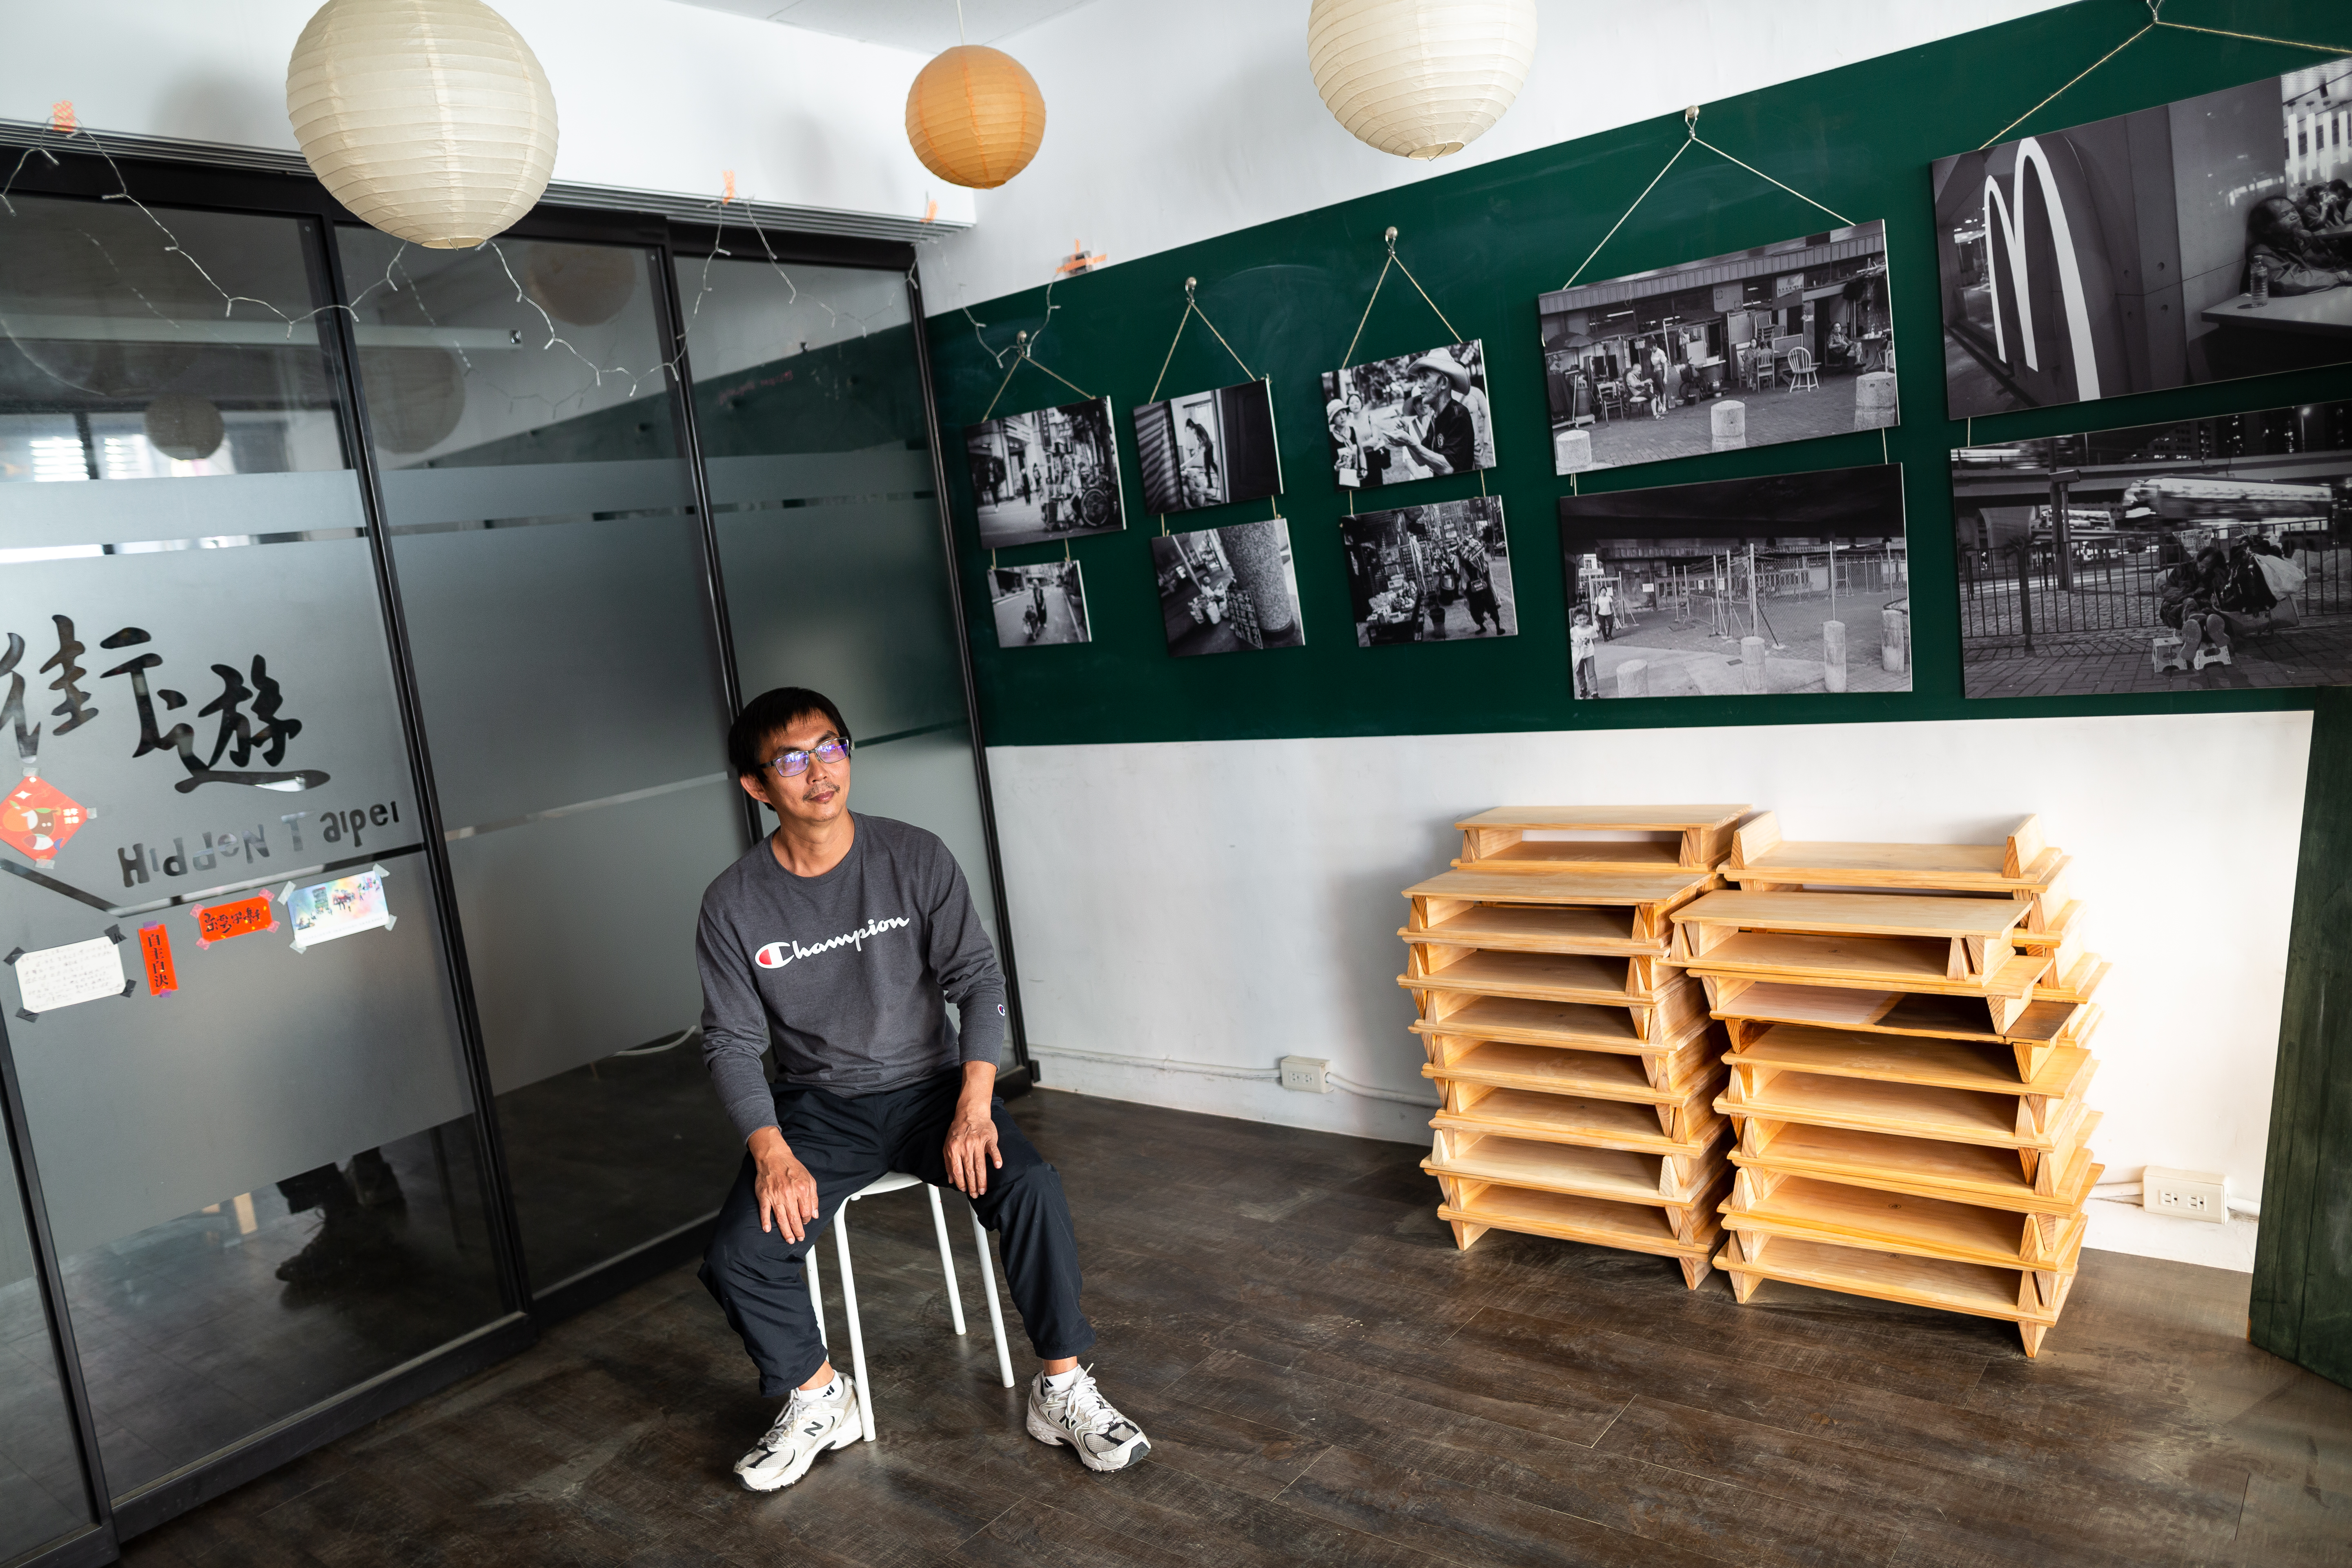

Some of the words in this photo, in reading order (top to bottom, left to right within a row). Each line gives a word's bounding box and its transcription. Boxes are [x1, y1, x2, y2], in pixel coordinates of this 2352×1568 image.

[148, 934, 168, 987] 自主自決
[755, 917, 910, 969] Champion
